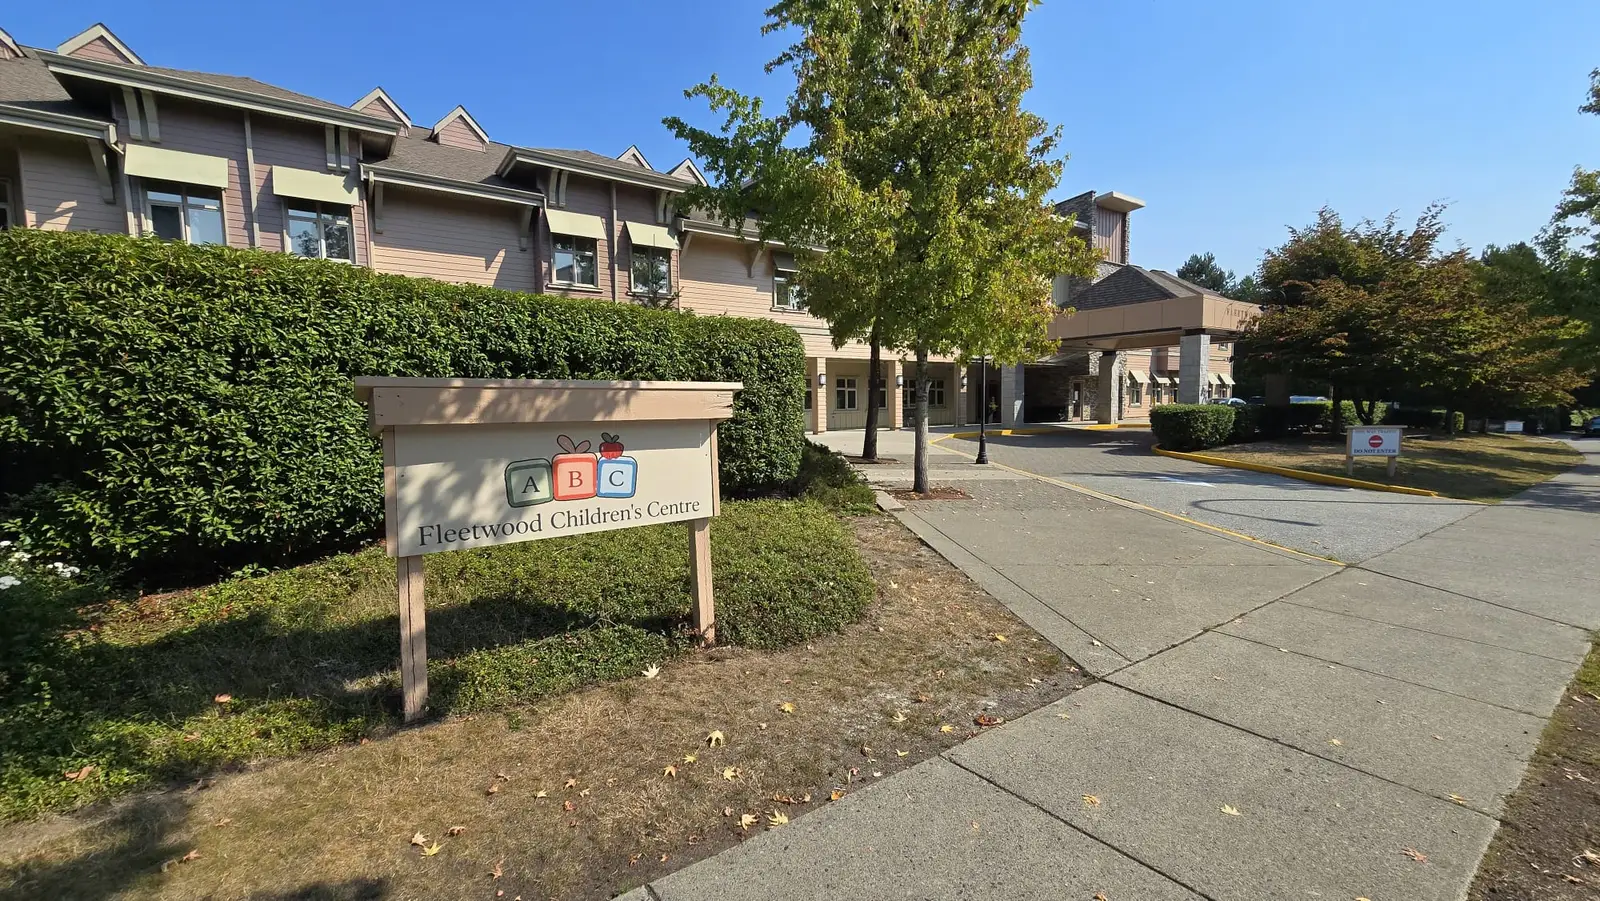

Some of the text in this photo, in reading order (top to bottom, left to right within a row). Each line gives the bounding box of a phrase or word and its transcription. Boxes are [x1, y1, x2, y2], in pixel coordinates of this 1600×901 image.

[521, 470, 625, 494] A B C
[418, 500, 701, 547] Fleetwood Children's Centre
